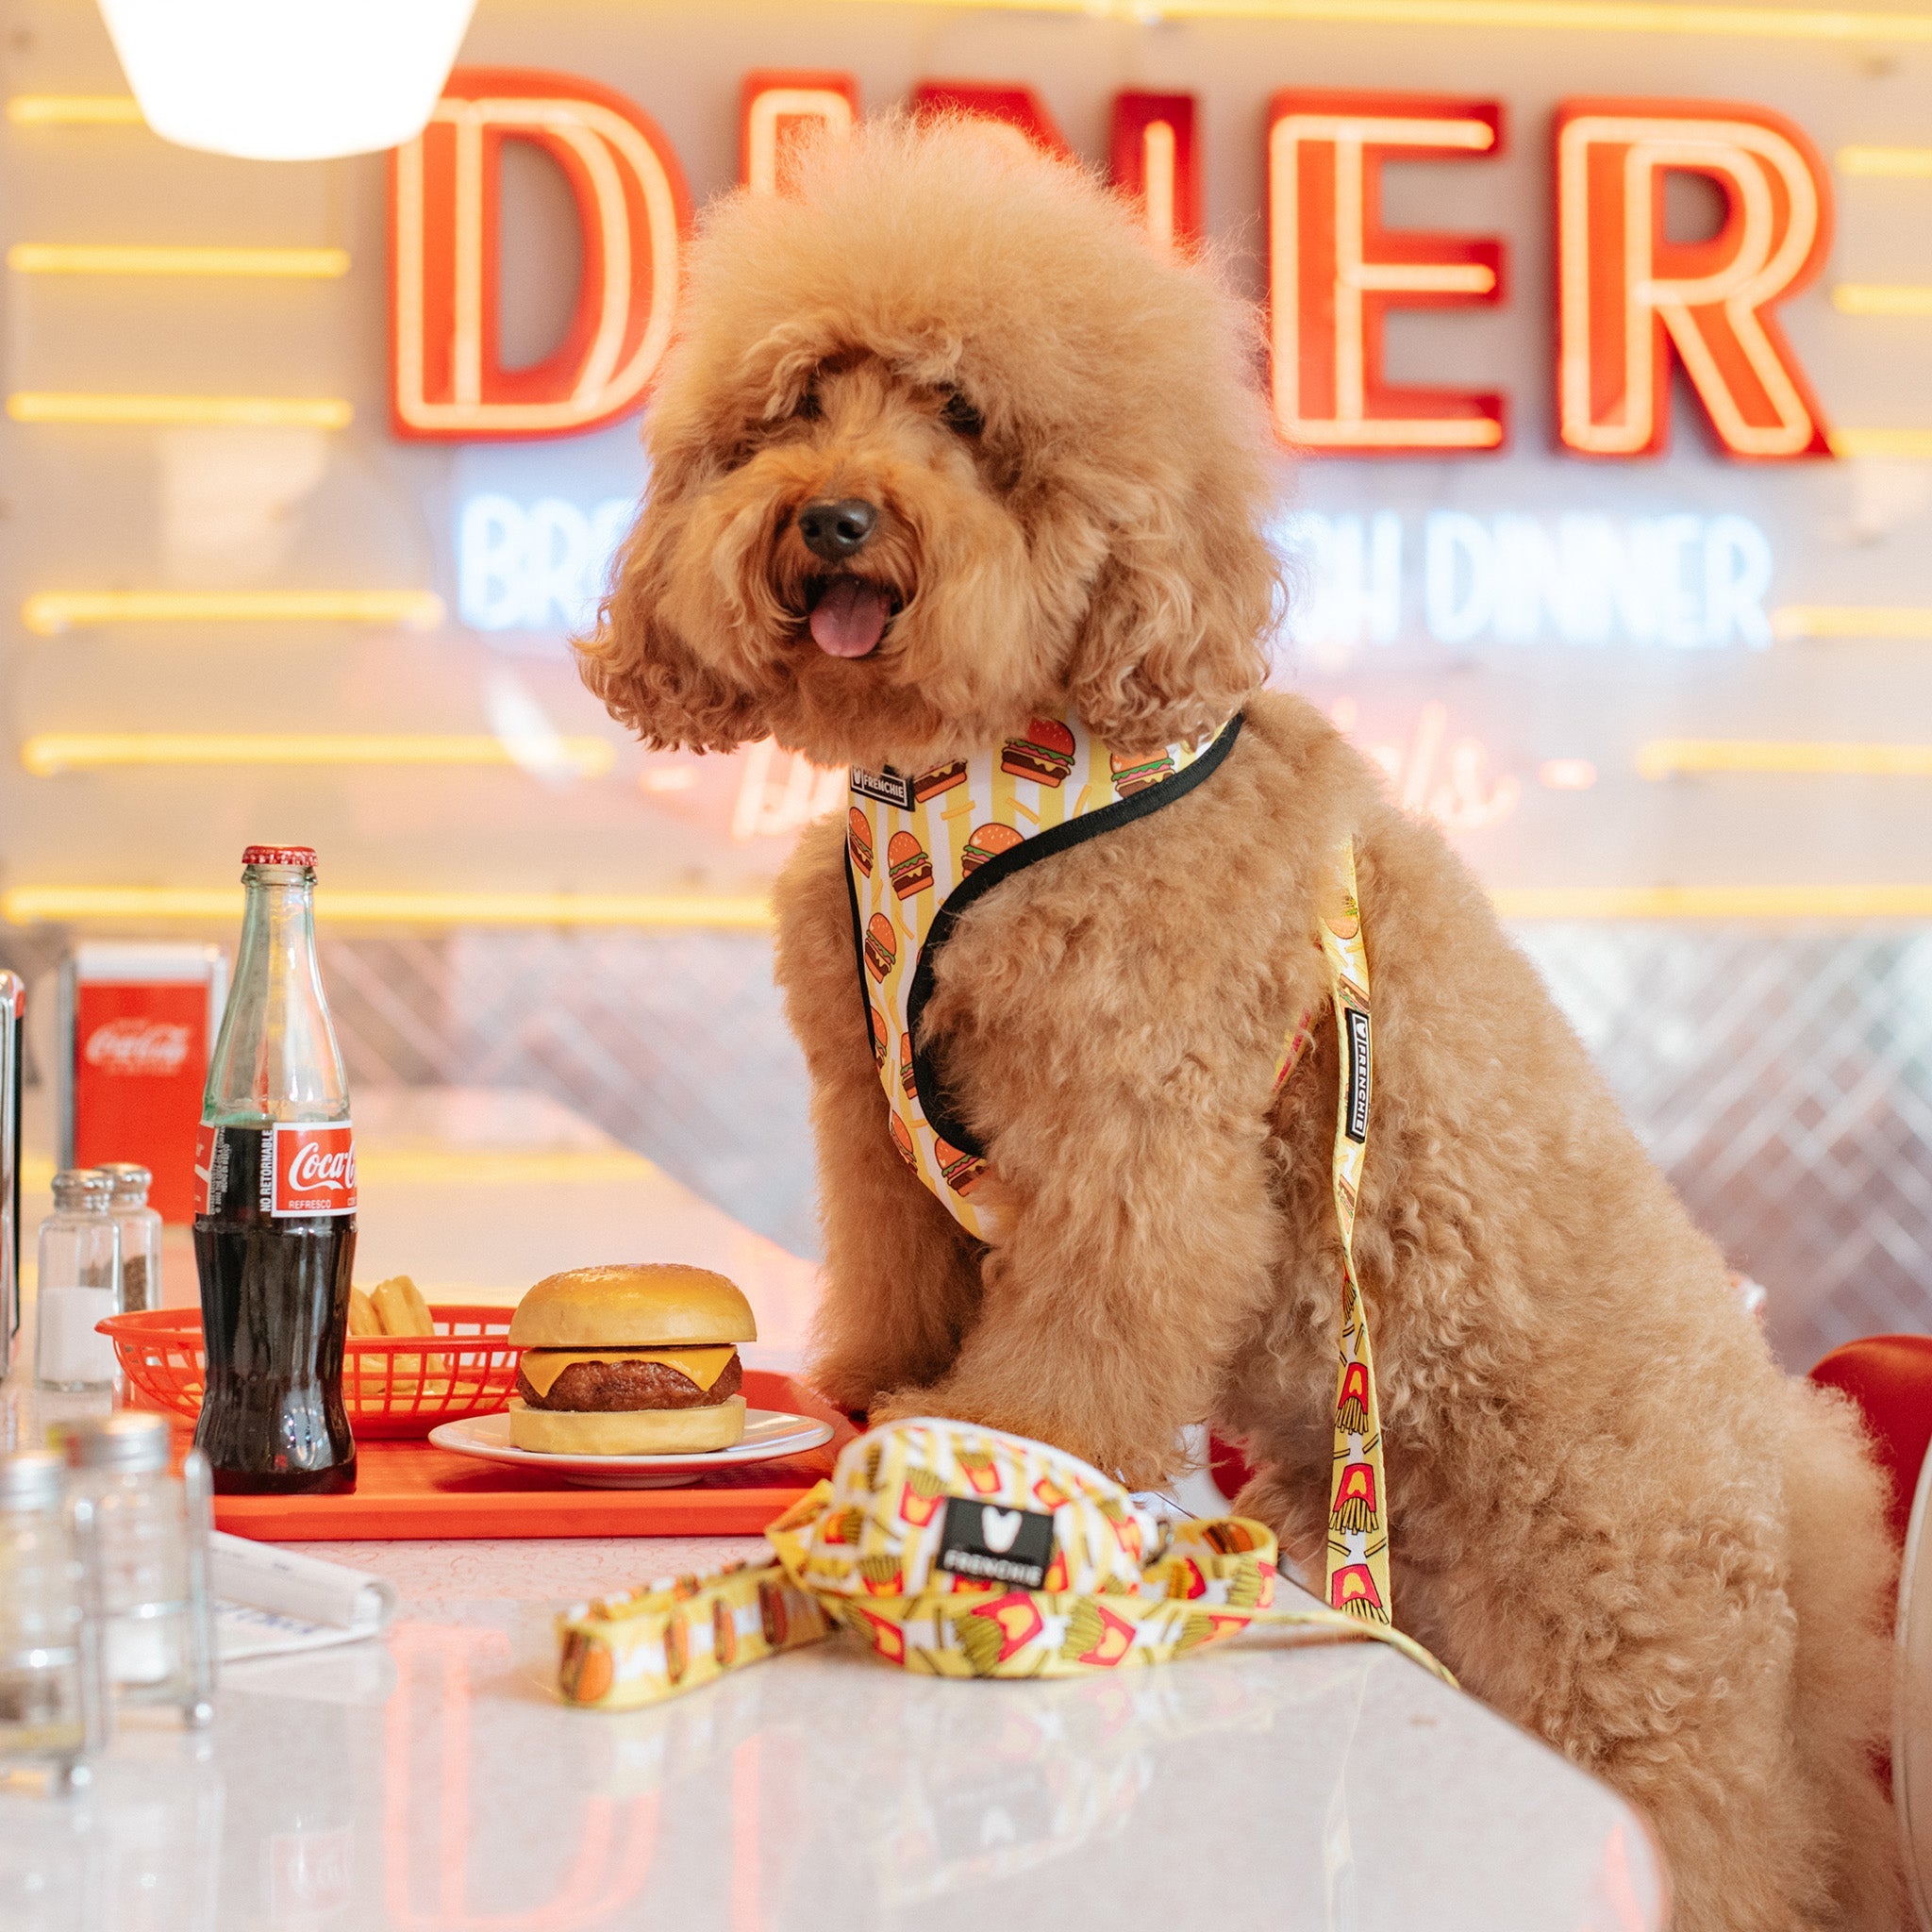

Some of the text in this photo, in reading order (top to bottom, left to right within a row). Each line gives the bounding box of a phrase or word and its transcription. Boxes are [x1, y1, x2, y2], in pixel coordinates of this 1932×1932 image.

[385, 64, 1840, 460] DER
[1423, 507, 1775, 651] DINNER
[863, 774, 905, 798] FRENCHIE
[1356, 1043, 1366, 1131] FRENCHIE
[259, 1129, 273, 1212] NO RETORNABLE
[288, 1141, 357, 1191] Coca-C
[288, 1198, 332, 1209] REFRESCO
[943, 1548, 1043, 1587] FRENCHIE
